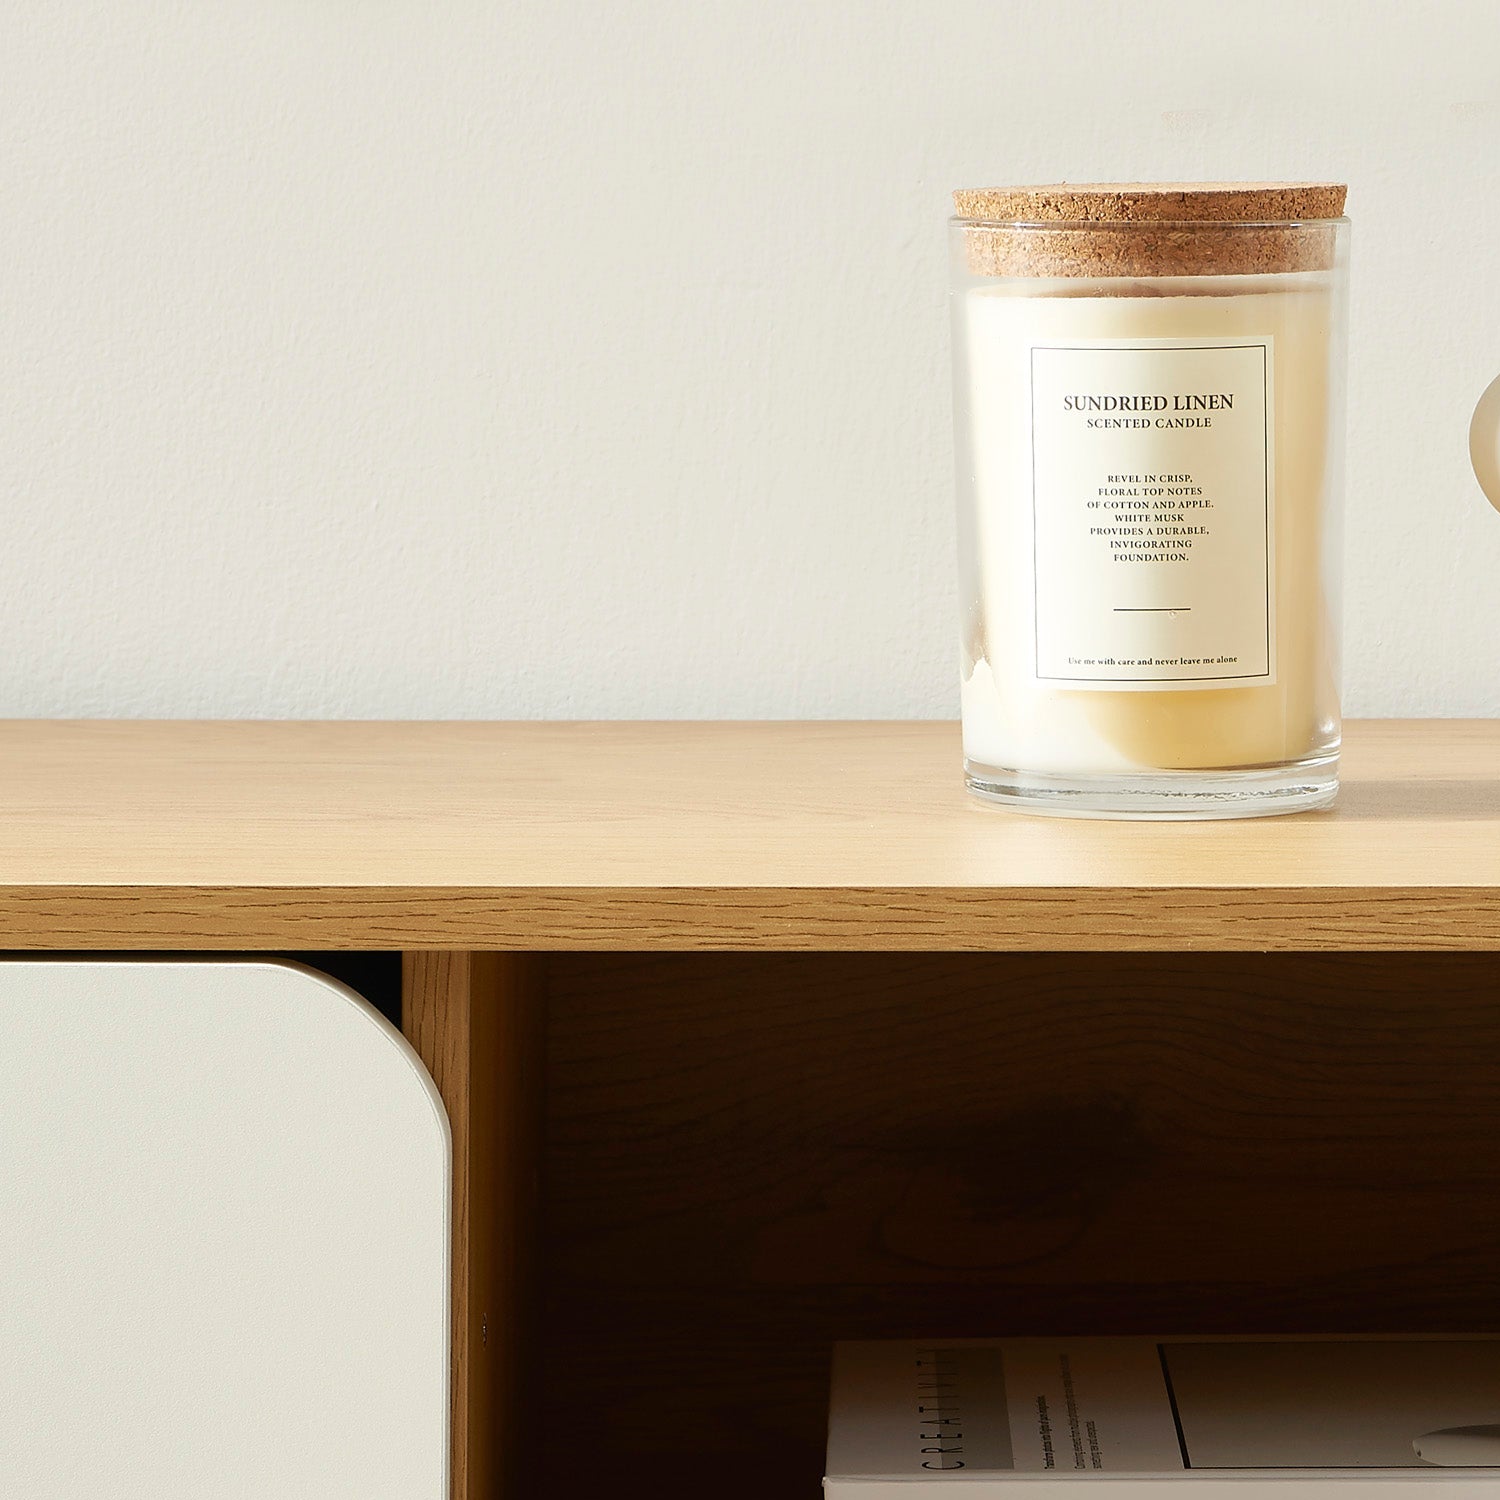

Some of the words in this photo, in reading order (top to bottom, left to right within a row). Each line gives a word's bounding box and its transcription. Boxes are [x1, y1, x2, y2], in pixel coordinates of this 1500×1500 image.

[1064, 395, 1168, 411] SUNDRIED
[1173, 394, 1234, 410] LINEN
[1087, 418, 1151, 429] SCENTED
[1155, 417, 1212, 428] CANDLE
[1107, 475, 1141, 483] REVEL
[1144, 475, 1157, 483] IN
[1098, 488, 1139, 496] FLORAL
[1142, 488, 1164, 496] TOP
[1167, 487, 1203, 495] NOTES
[1087, 501, 1101, 509] OF
[1103, 501, 1149, 509] COTTON
[1152, 501, 1176, 509] AND
[1115, 514, 1151, 522] WHITE
[1154, 513, 1185, 522] MUSK
[1090, 527, 1144, 535] PROVIDES
[1146, 527, 1154, 535] A
[1110, 540, 1192, 548] INVIGORATING
[1114, 553, 1189, 562] FOUNDATION.
[1068, 657, 1081, 665] Use
[1098, 657, 1115, 665] with
[1137, 657, 1152, 665] and
[1180, 657, 1201, 665] leave
[1216, 655, 1238, 663] alone
